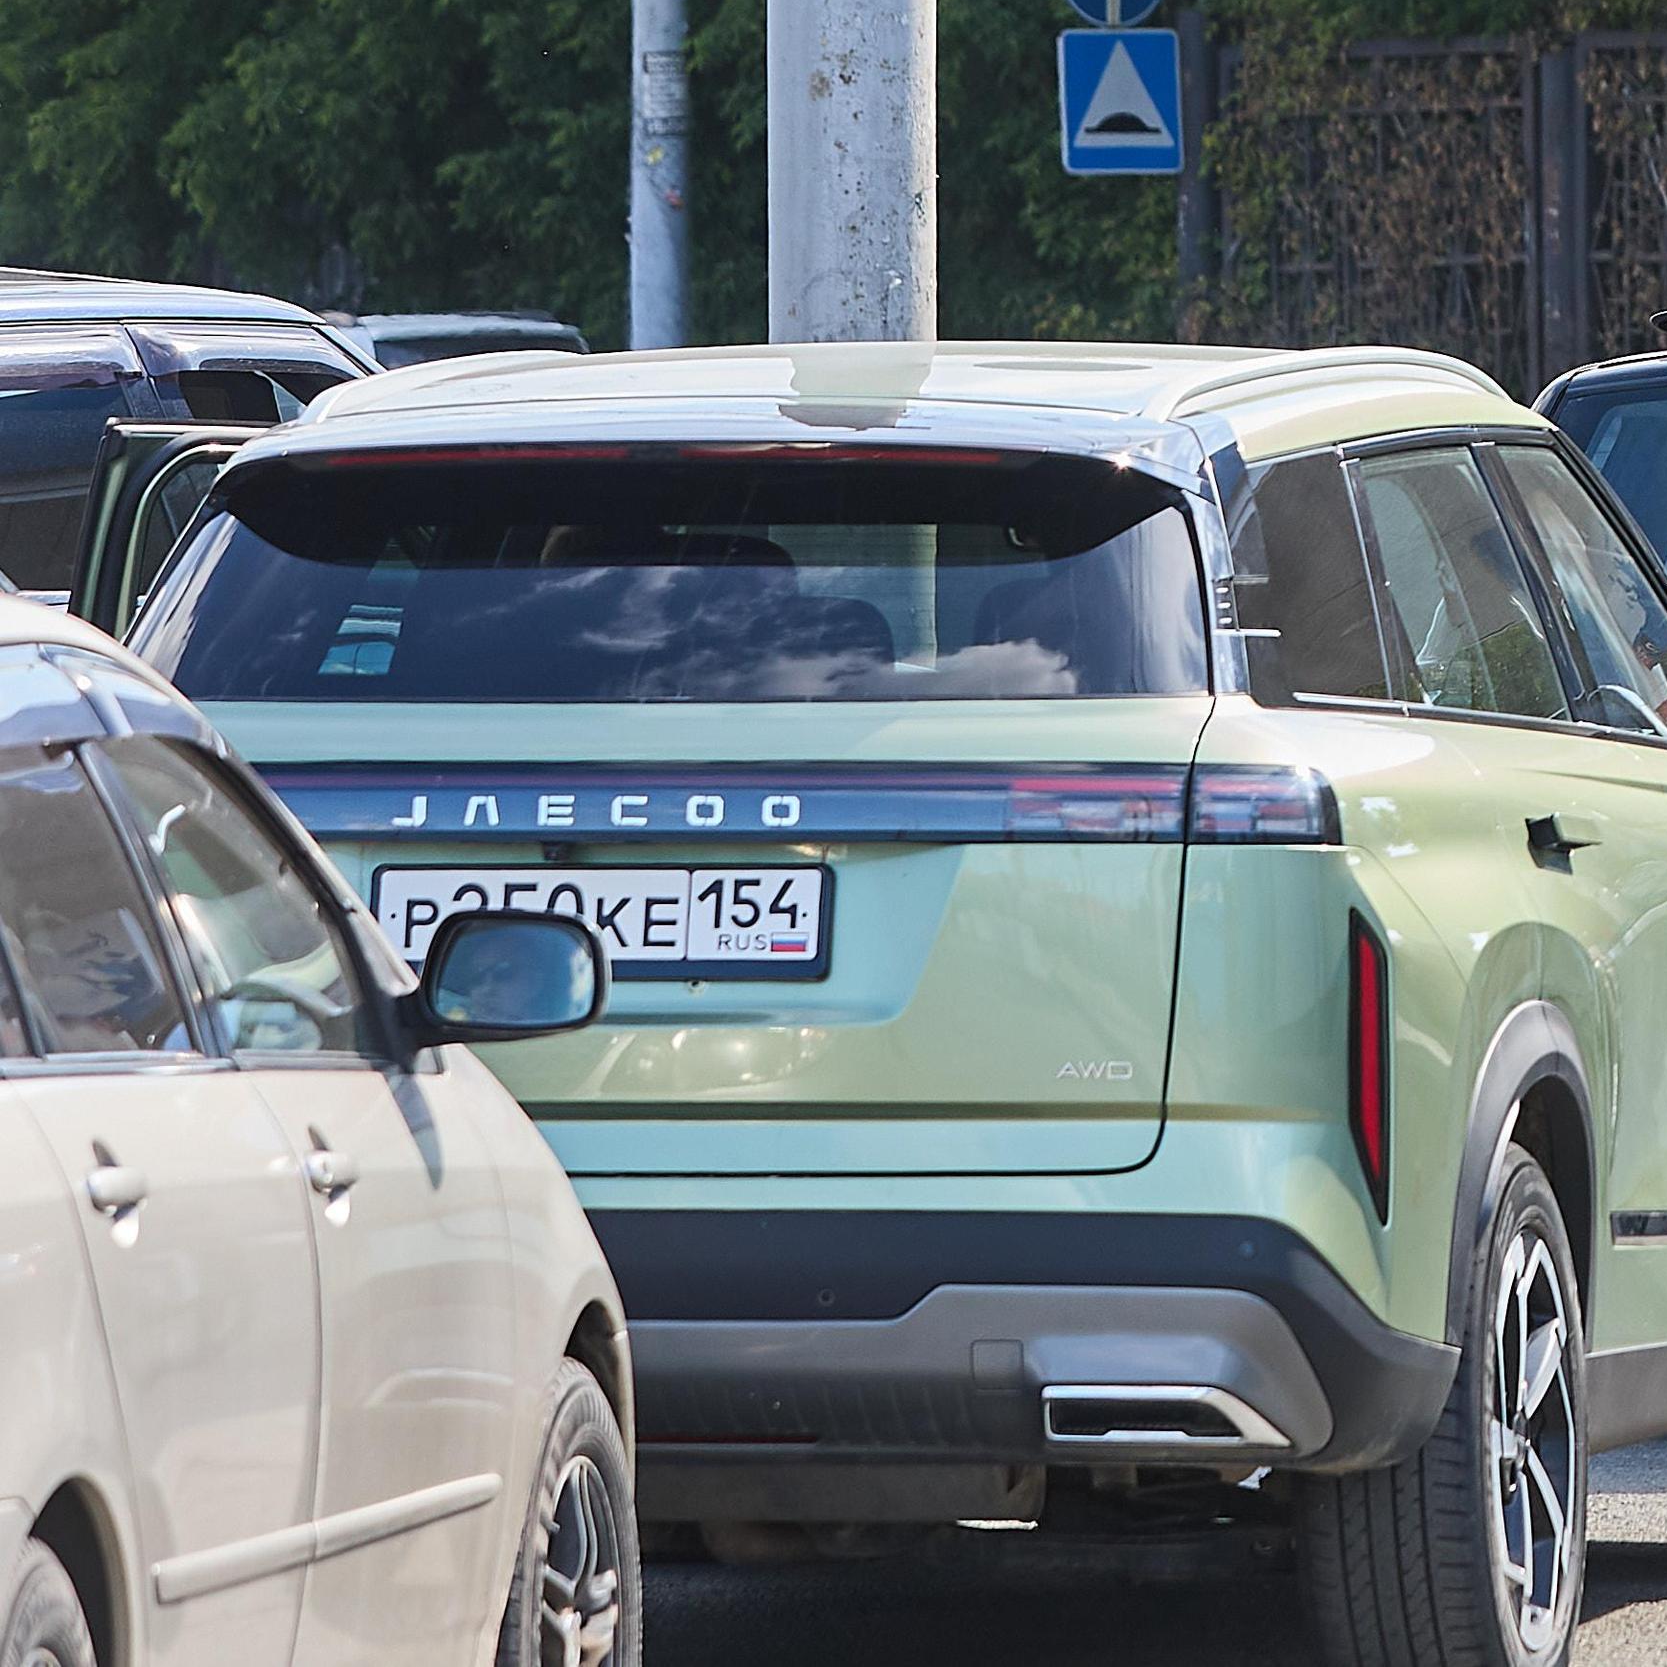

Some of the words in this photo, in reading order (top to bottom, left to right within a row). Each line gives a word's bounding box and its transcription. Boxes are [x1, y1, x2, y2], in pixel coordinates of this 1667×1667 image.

[696, 878, 800, 930] 154
[716, 933, 768, 952] RUS
[1056, 1060, 1133, 1081] AWD
